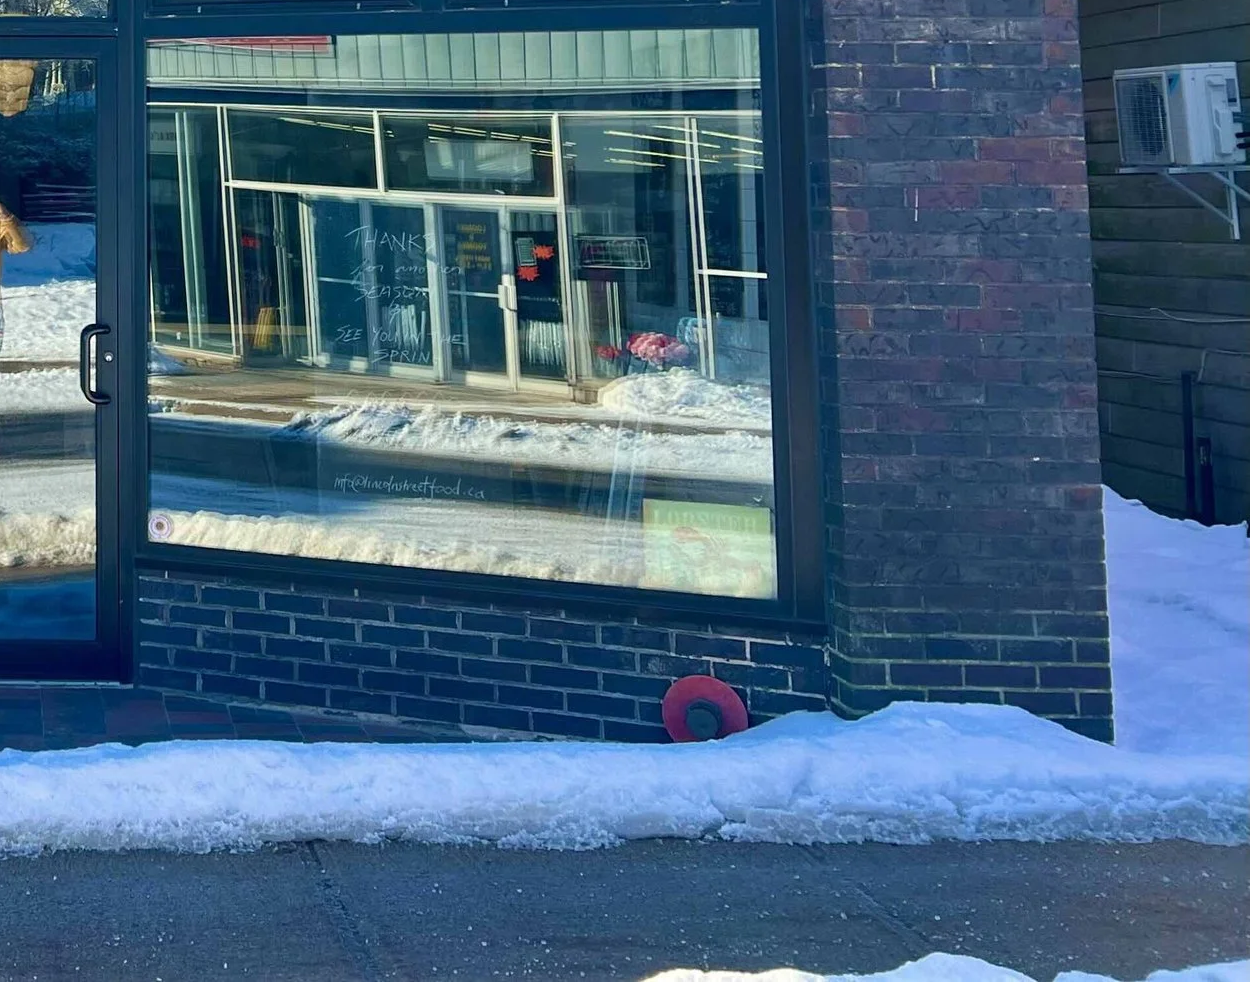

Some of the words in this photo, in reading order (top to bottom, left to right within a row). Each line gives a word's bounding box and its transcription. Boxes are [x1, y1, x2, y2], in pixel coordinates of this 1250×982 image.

[344, 226, 436, 254] THANKS
[350, 258, 383, 283] for
[395, 263, 462, 275] anoer
[354, 284, 428, 302] SEASON
[334, 325, 363, 342] SEE
[371, 325, 398, 345] YOU
[427, 331, 466, 345] HE
[372, 349, 431, 364] SPRIN
[333, 474, 485, 499] info@lincolnstreetfood.ca
